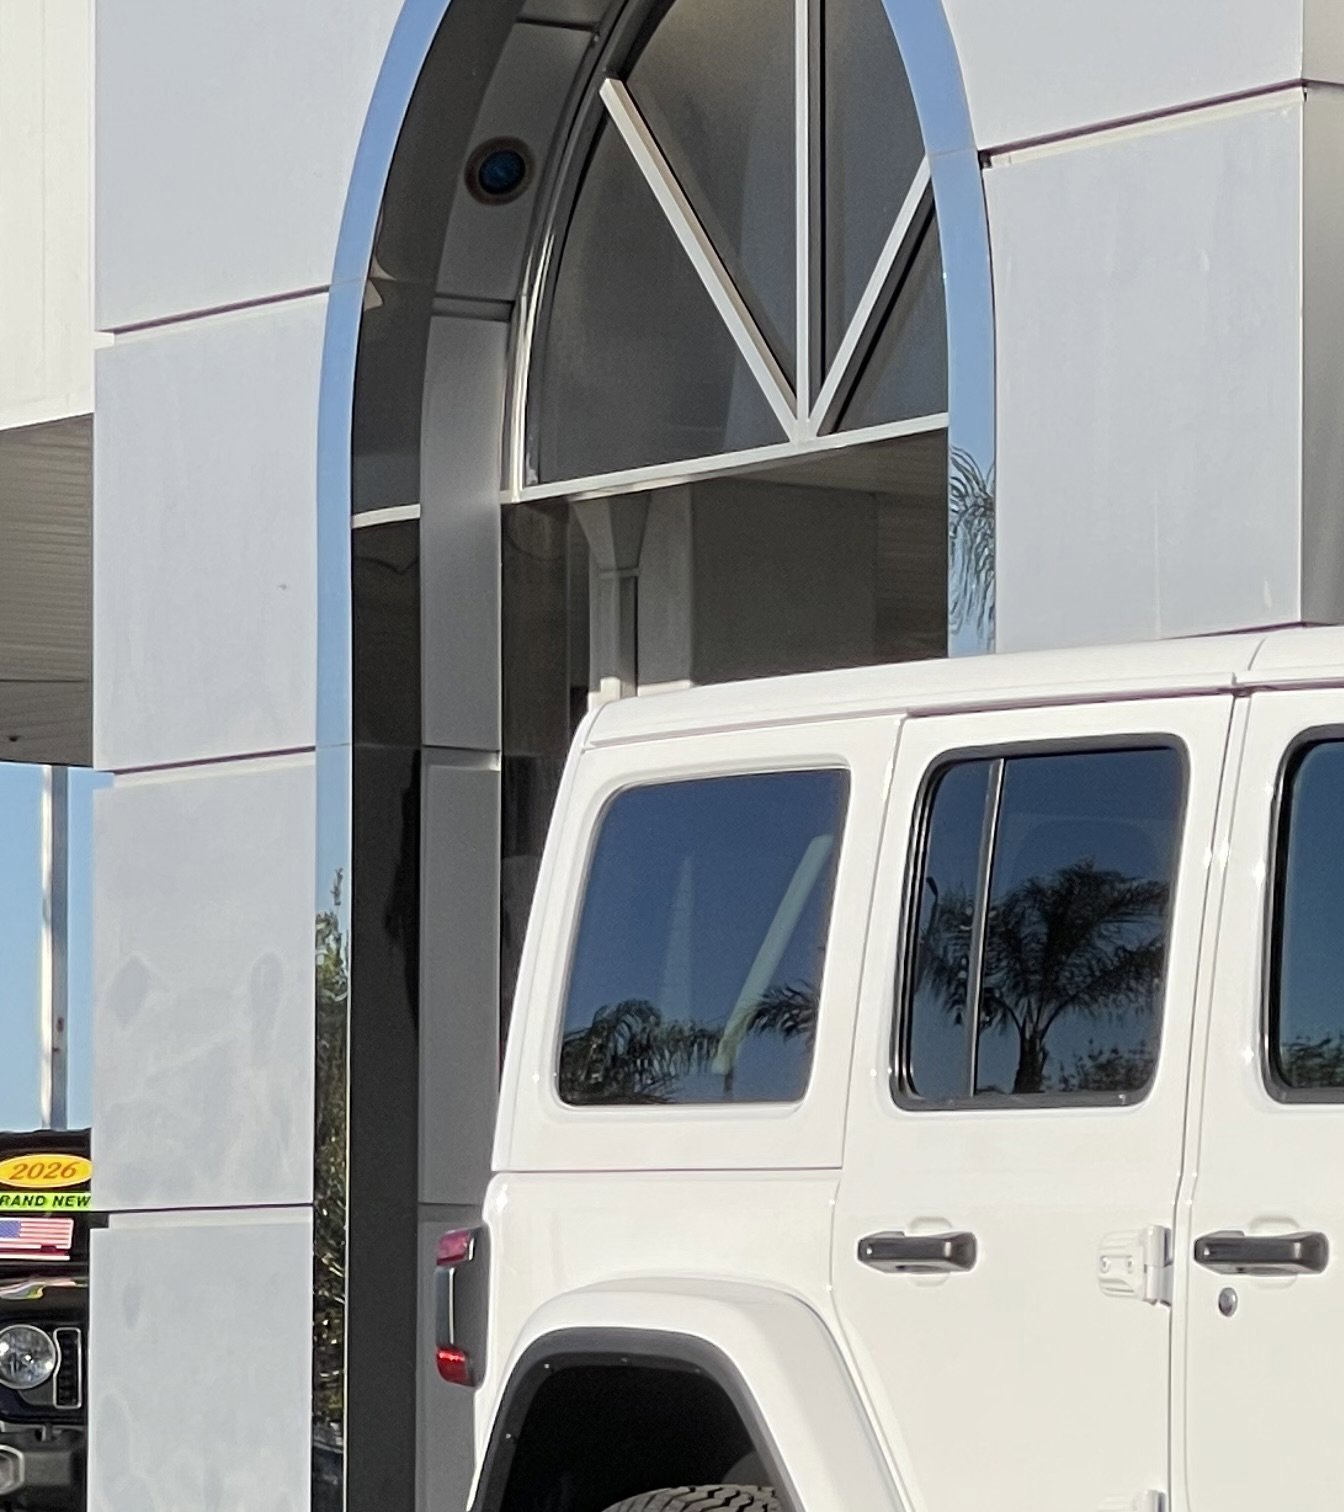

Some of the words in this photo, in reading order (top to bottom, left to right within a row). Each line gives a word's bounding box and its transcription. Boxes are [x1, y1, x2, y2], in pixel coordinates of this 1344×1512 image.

[9, 1161, 80, 1181] 2026
[0, 1194, 47, 1207] RAND
[52, 1195, 91, 1207] NEW
